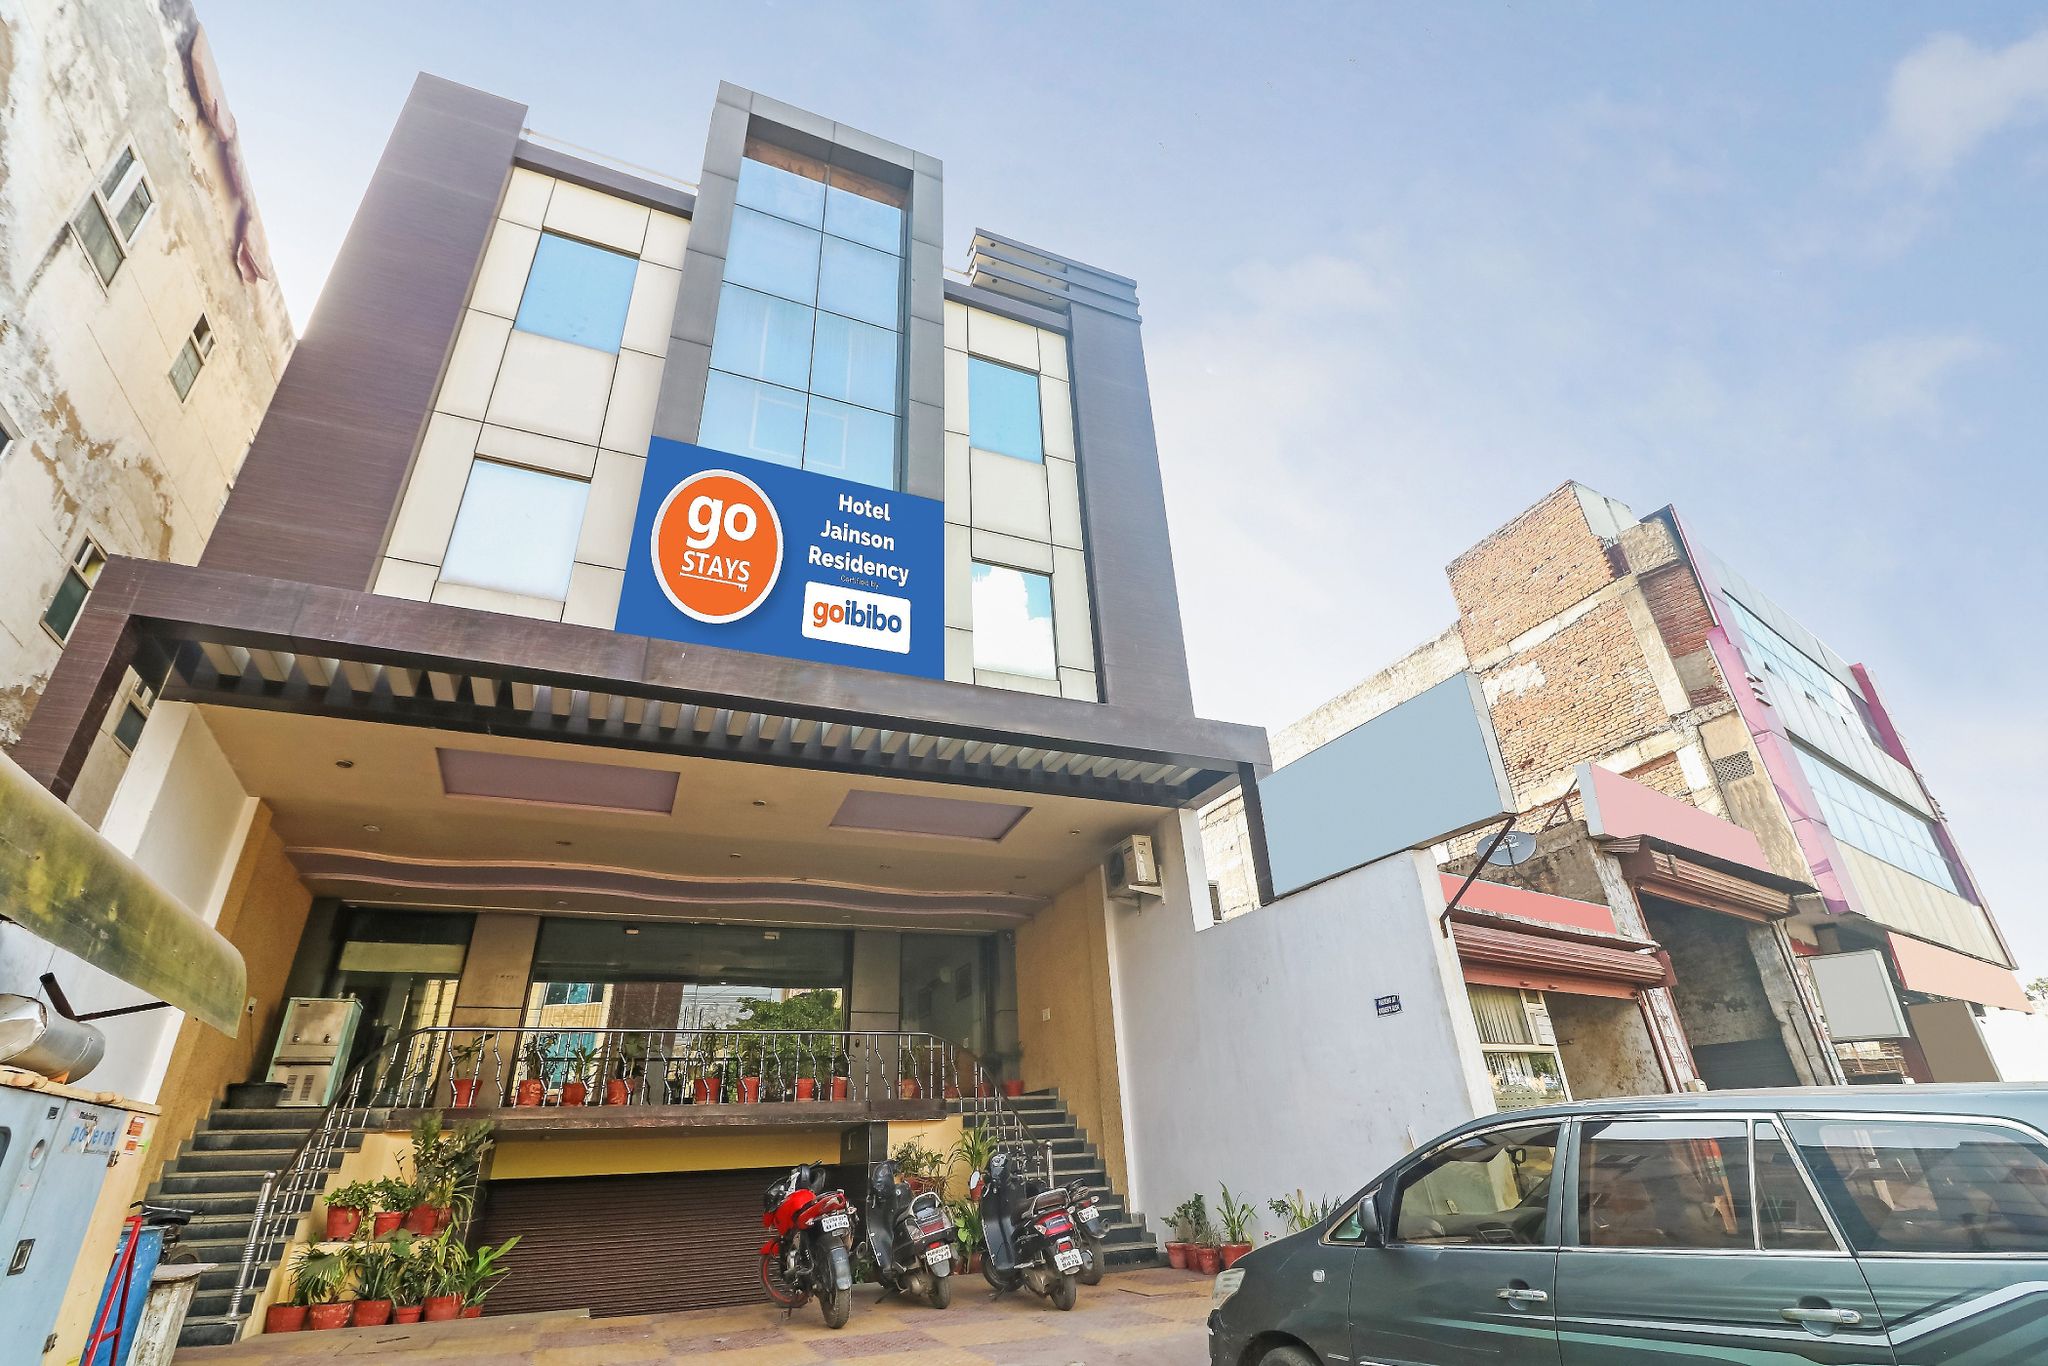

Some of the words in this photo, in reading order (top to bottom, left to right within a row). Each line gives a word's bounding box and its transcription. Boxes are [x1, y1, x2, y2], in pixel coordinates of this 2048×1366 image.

[686, 495, 757, 550] go
[839, 493, 891, 521] Hotel
[820, 519, 895, 551] Jainson
[681, 550, 751, 582] STAYS
[808, 545, 909, 587] Residency
[813, 600, 902, 633] goibibo
